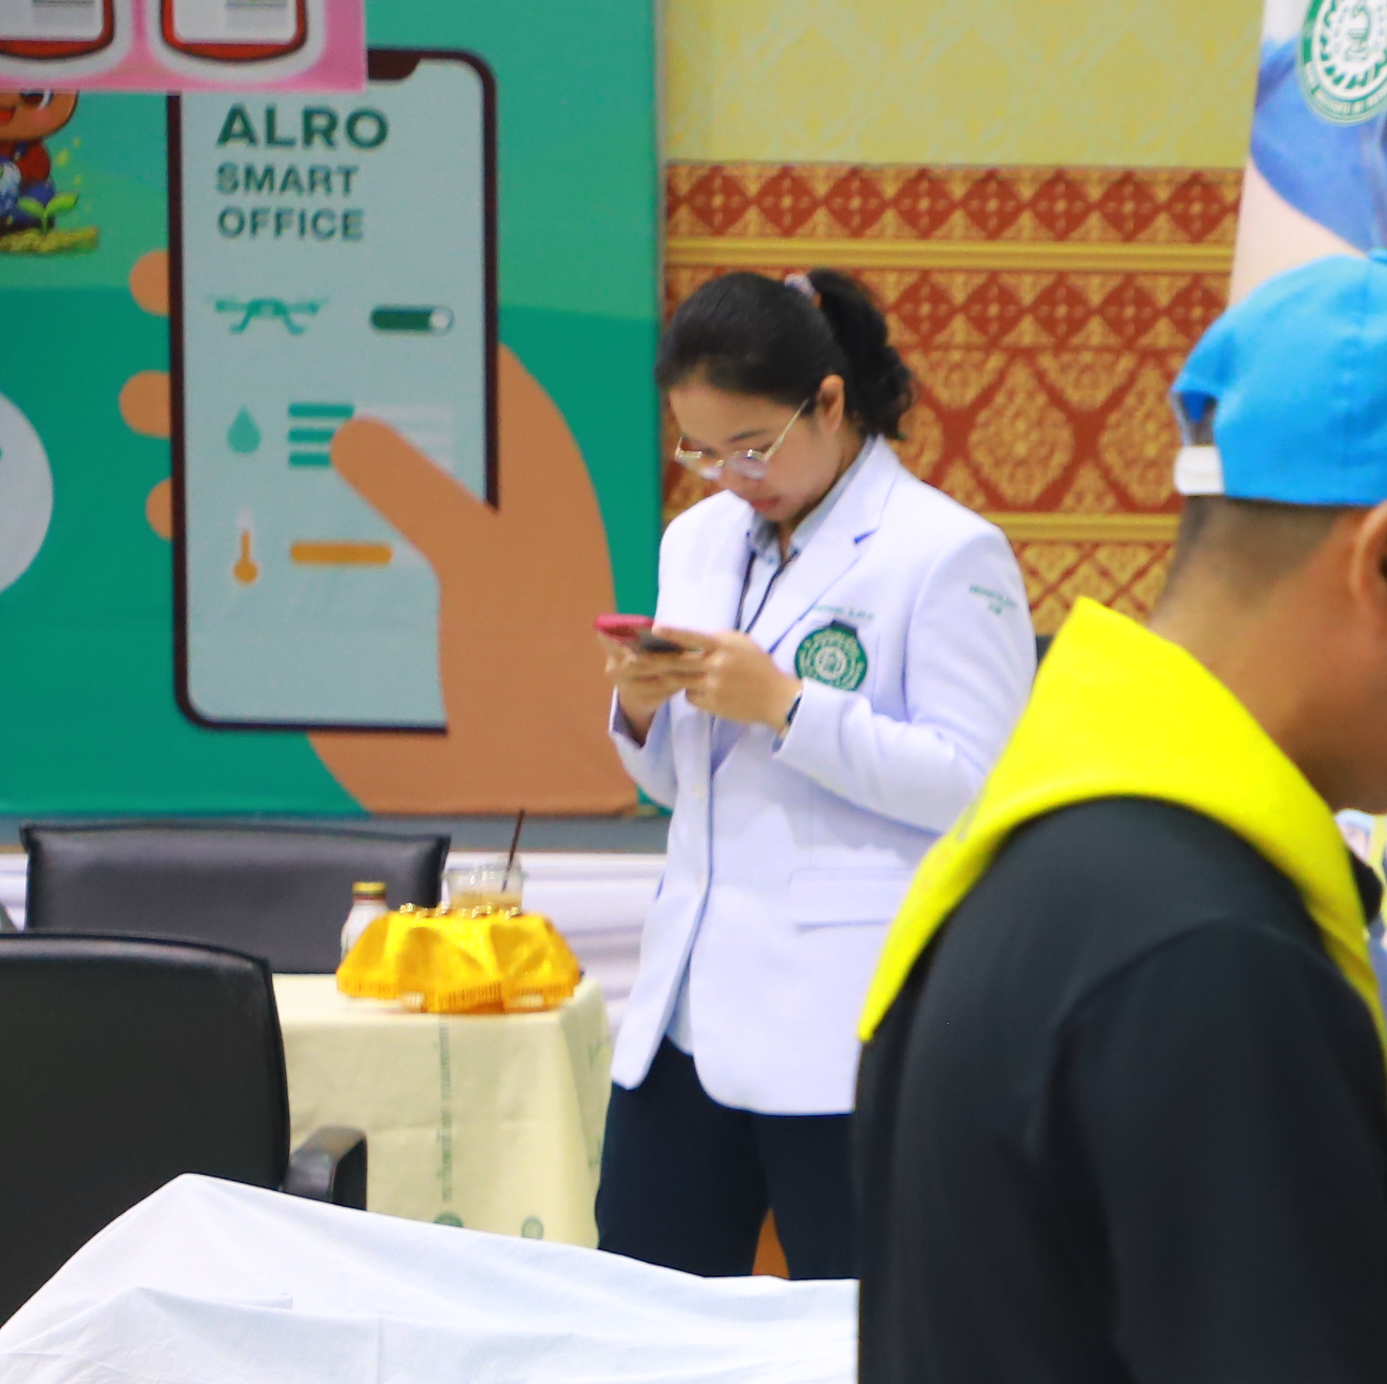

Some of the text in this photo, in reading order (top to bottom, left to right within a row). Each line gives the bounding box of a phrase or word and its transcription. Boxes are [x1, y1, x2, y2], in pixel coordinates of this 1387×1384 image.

[216, 103, 389, 149] ALRO
[216, 161, 358, 196] SMART
[217, 205, 364, 240] OFFICE
